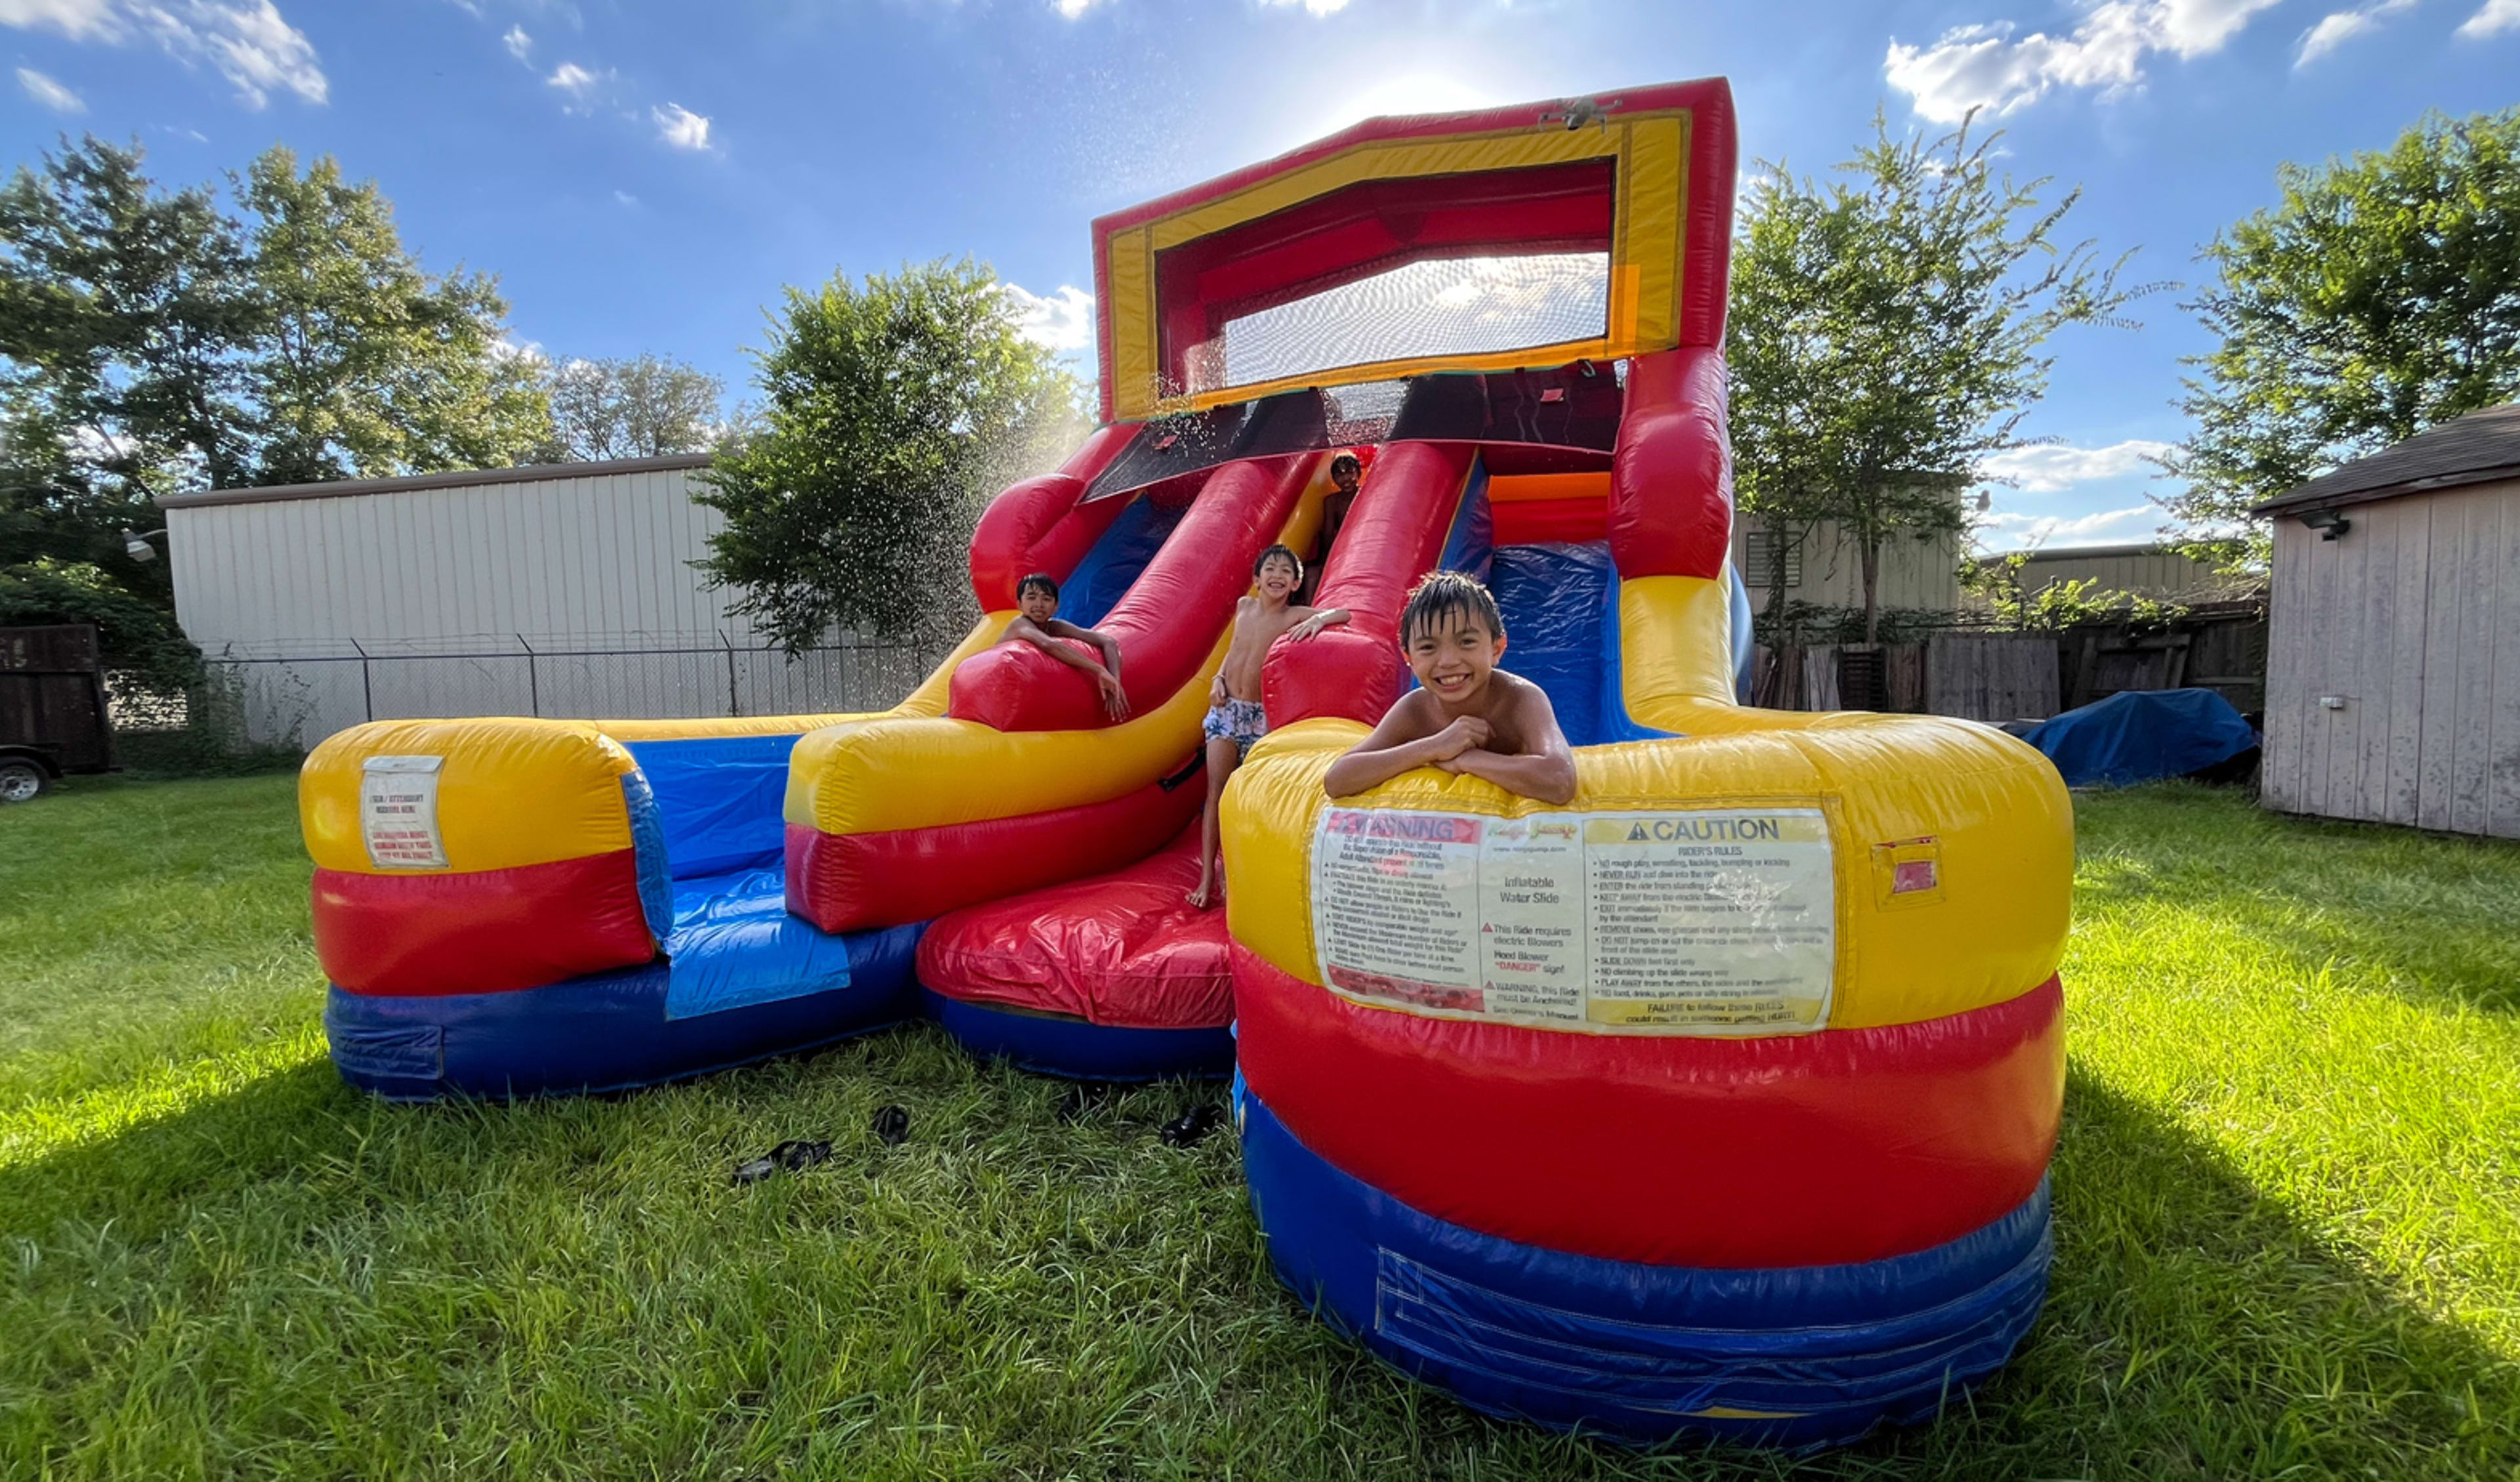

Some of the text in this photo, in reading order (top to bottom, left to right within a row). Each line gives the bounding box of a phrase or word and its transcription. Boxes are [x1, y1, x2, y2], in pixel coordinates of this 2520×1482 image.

[1652, 819, 1780, 841] CAUTION
[1505, 877, 1554, 887] Inflatable
[1500, 892, 1559, 904] Water Slide
[1494, 923, 1511, 934] This
[1535, 925, 1572, 937] requires
